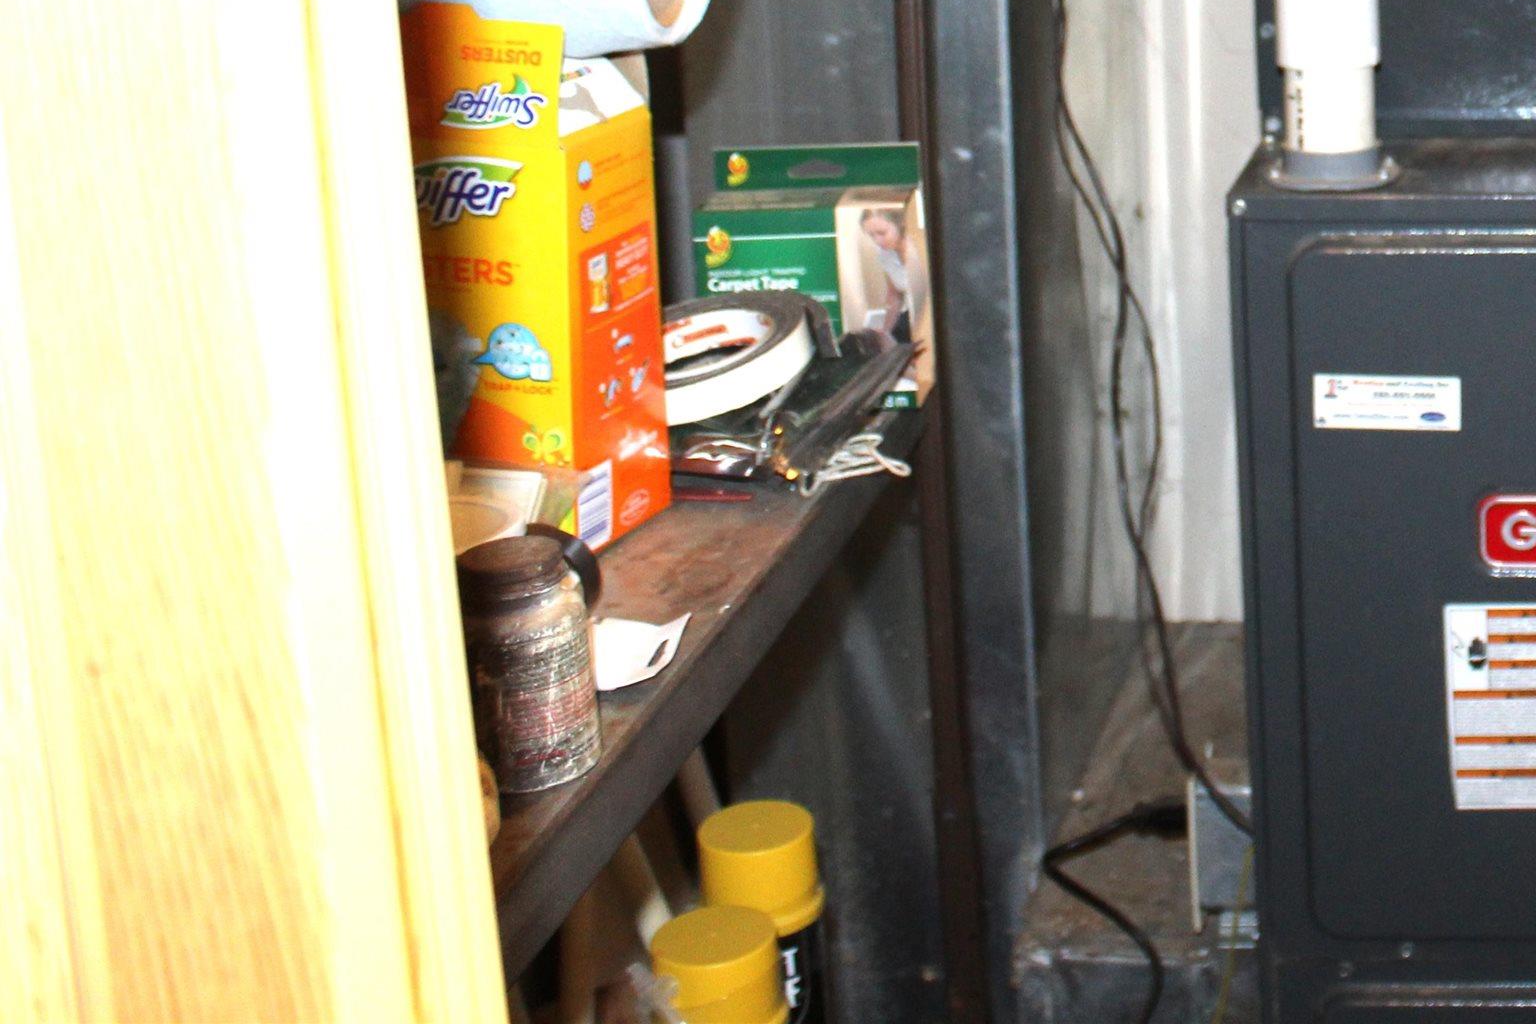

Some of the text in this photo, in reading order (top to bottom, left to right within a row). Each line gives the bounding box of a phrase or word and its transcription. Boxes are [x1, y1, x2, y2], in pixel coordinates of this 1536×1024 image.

[461, 43, 542, 67] DUSTERS
[448, 85, 544, 125] Swiffer
[424, 255, 514, 286] TERS
[707, 275, 800, 294] Carpet Tape
